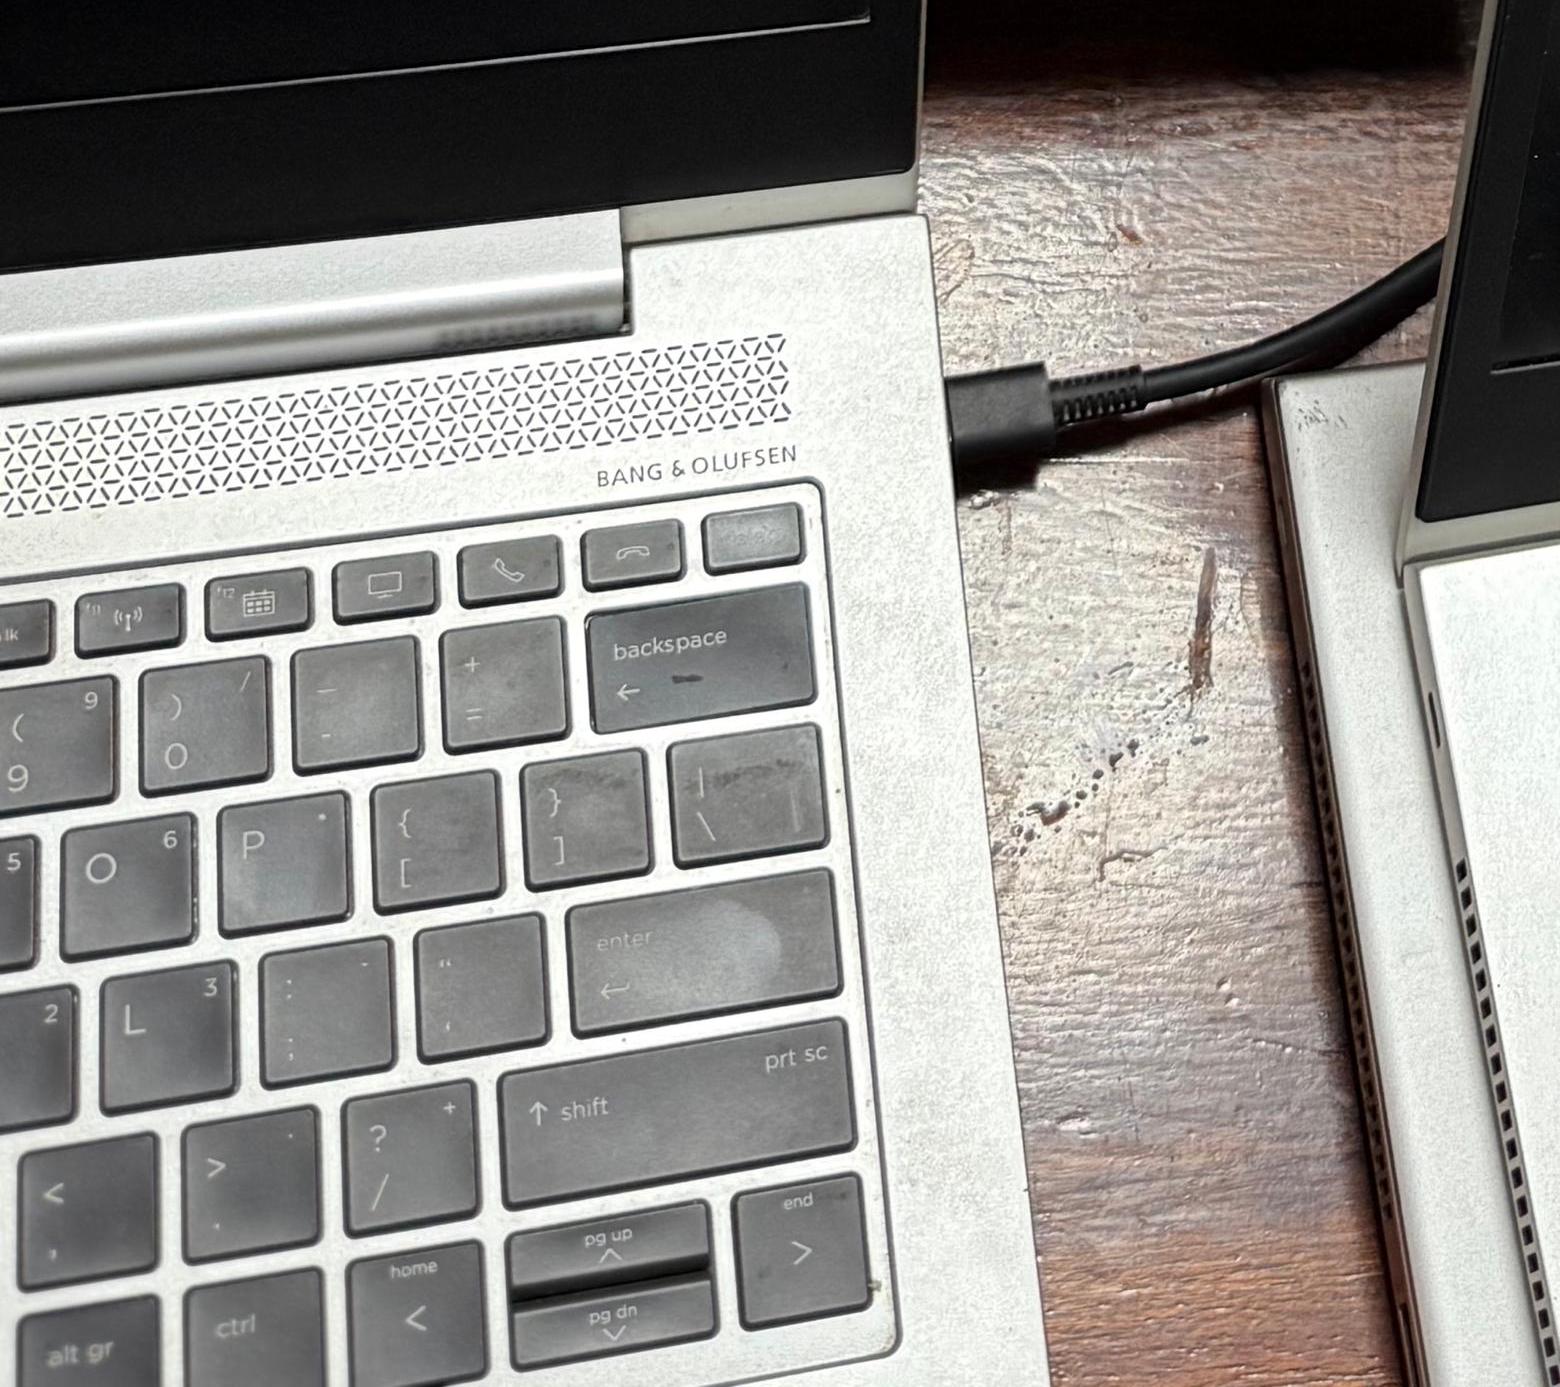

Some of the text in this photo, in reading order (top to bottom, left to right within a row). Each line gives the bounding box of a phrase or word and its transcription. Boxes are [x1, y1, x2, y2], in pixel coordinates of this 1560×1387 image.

[597, 444, 796, 488] BANG & OLUFSEN
[613, 630, 727, 661] backspace
[84, 691, 98, 710] 9
[6, 764, 29, 793] 9
[162, 830, 178, 849] 6
[241, 830, 265, 861] P
[6, 852, 21, 872] 5
[85, 852, 117, 885] O
[596, 931, 653, 956] enter
[204, 977, 218, 997] 3
[44, 1003, 59, 1024] 2
[123, 1004, 147, 1036] L
[765, 1045, 828, 1074] prt sc
[561, 1096, 609, 1122] shift
[783, 1192, 814, 1211] end
[584, 1228, 633, 1248] pg up
[389, 1261, 438, 1279] home
[214, 1314, 256, 1340] ctrl
[589, 1304, 638, 1326] pg dn
[47, 1341, 114, 1368] alt gr
